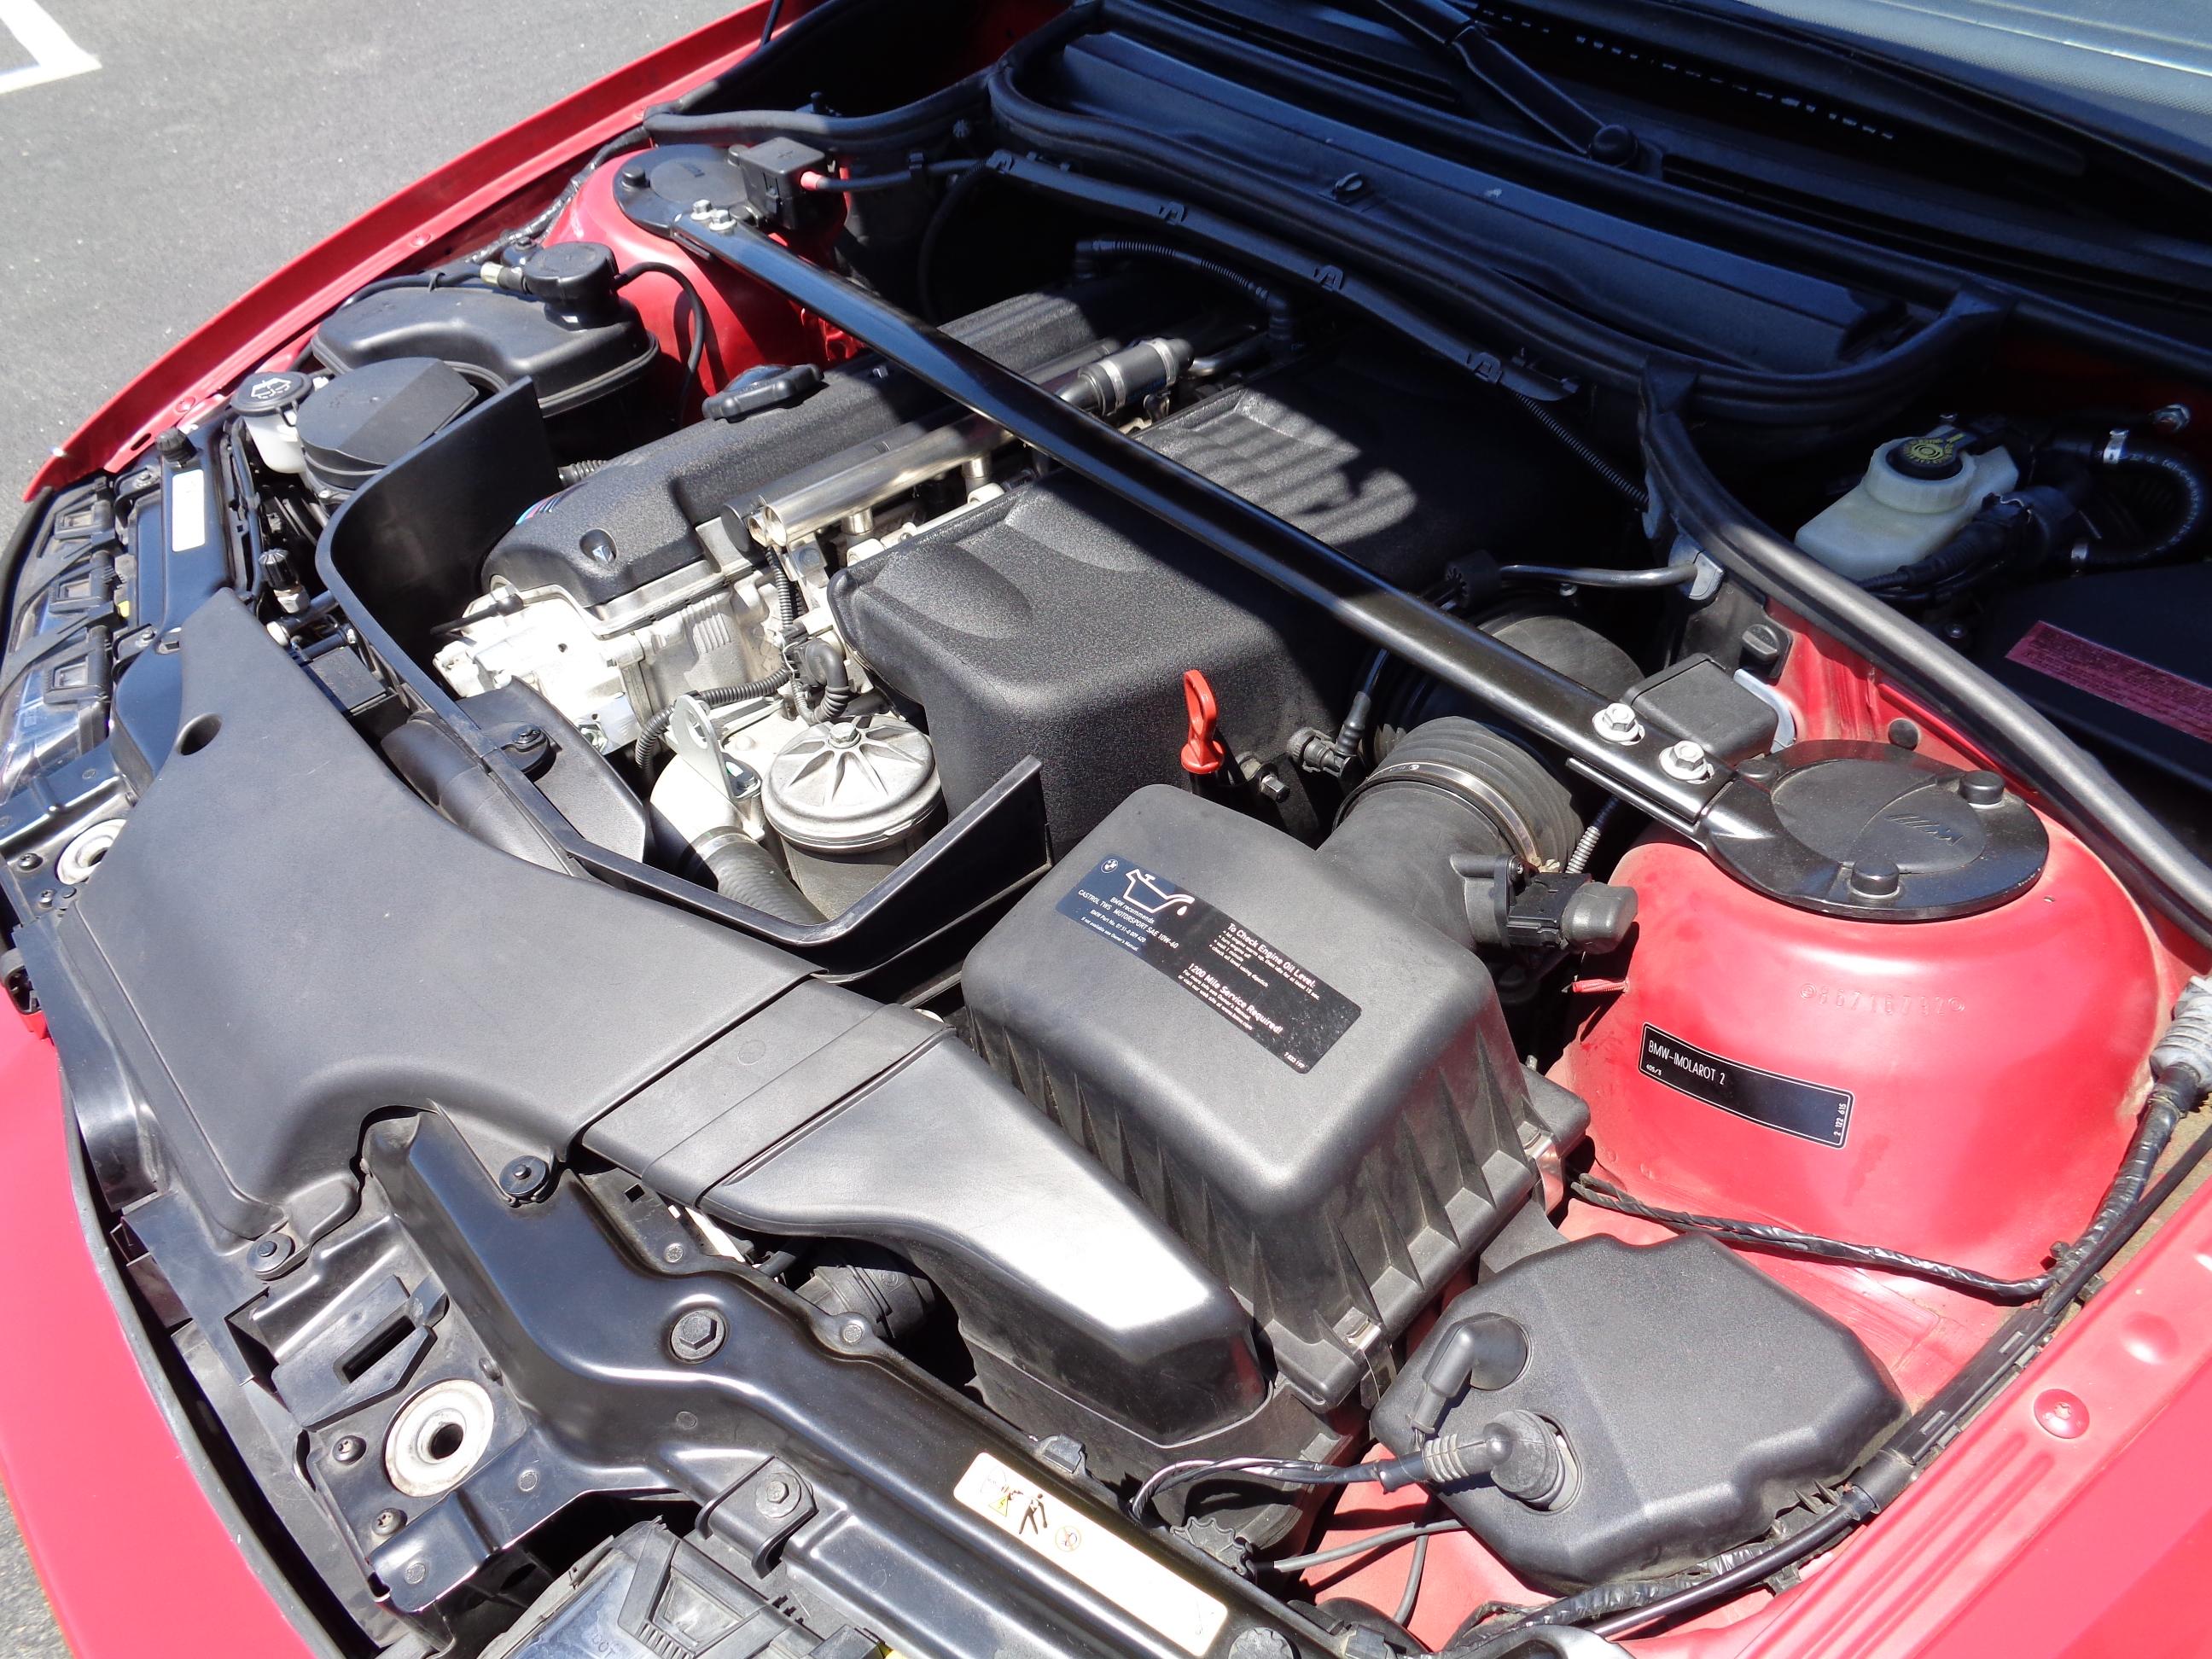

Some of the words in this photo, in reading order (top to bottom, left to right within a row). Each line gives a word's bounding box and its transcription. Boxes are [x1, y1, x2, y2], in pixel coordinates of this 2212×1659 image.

[1078, 889, 1100, 905] CASTROL
[1113, 908, 1149, 929] MOTORSPORT
[1157, 933, 1179, 948] 10W-60
[1122, 905, 1155, 924] recommends
[1236, 929, 1259, 948] Check
[1257, 944, 1283, 965] Engine
[1293, 969, 1316, 988] Level:
[1251, 974, 1268, 987] dipstick
[1188, 963, 1206, 978] 1200
[1203, 974, 1220, 989] Mile
[1220, 986, 1247, 1009] Service
[1246, 1004, 1284, 1034] Required!
[1648, 1039, 1717, 1081] BMW-IMOLAROT
[1719, 1072, 1726, 1086] 2
[1837, 1103, 1847, 1115] 615
